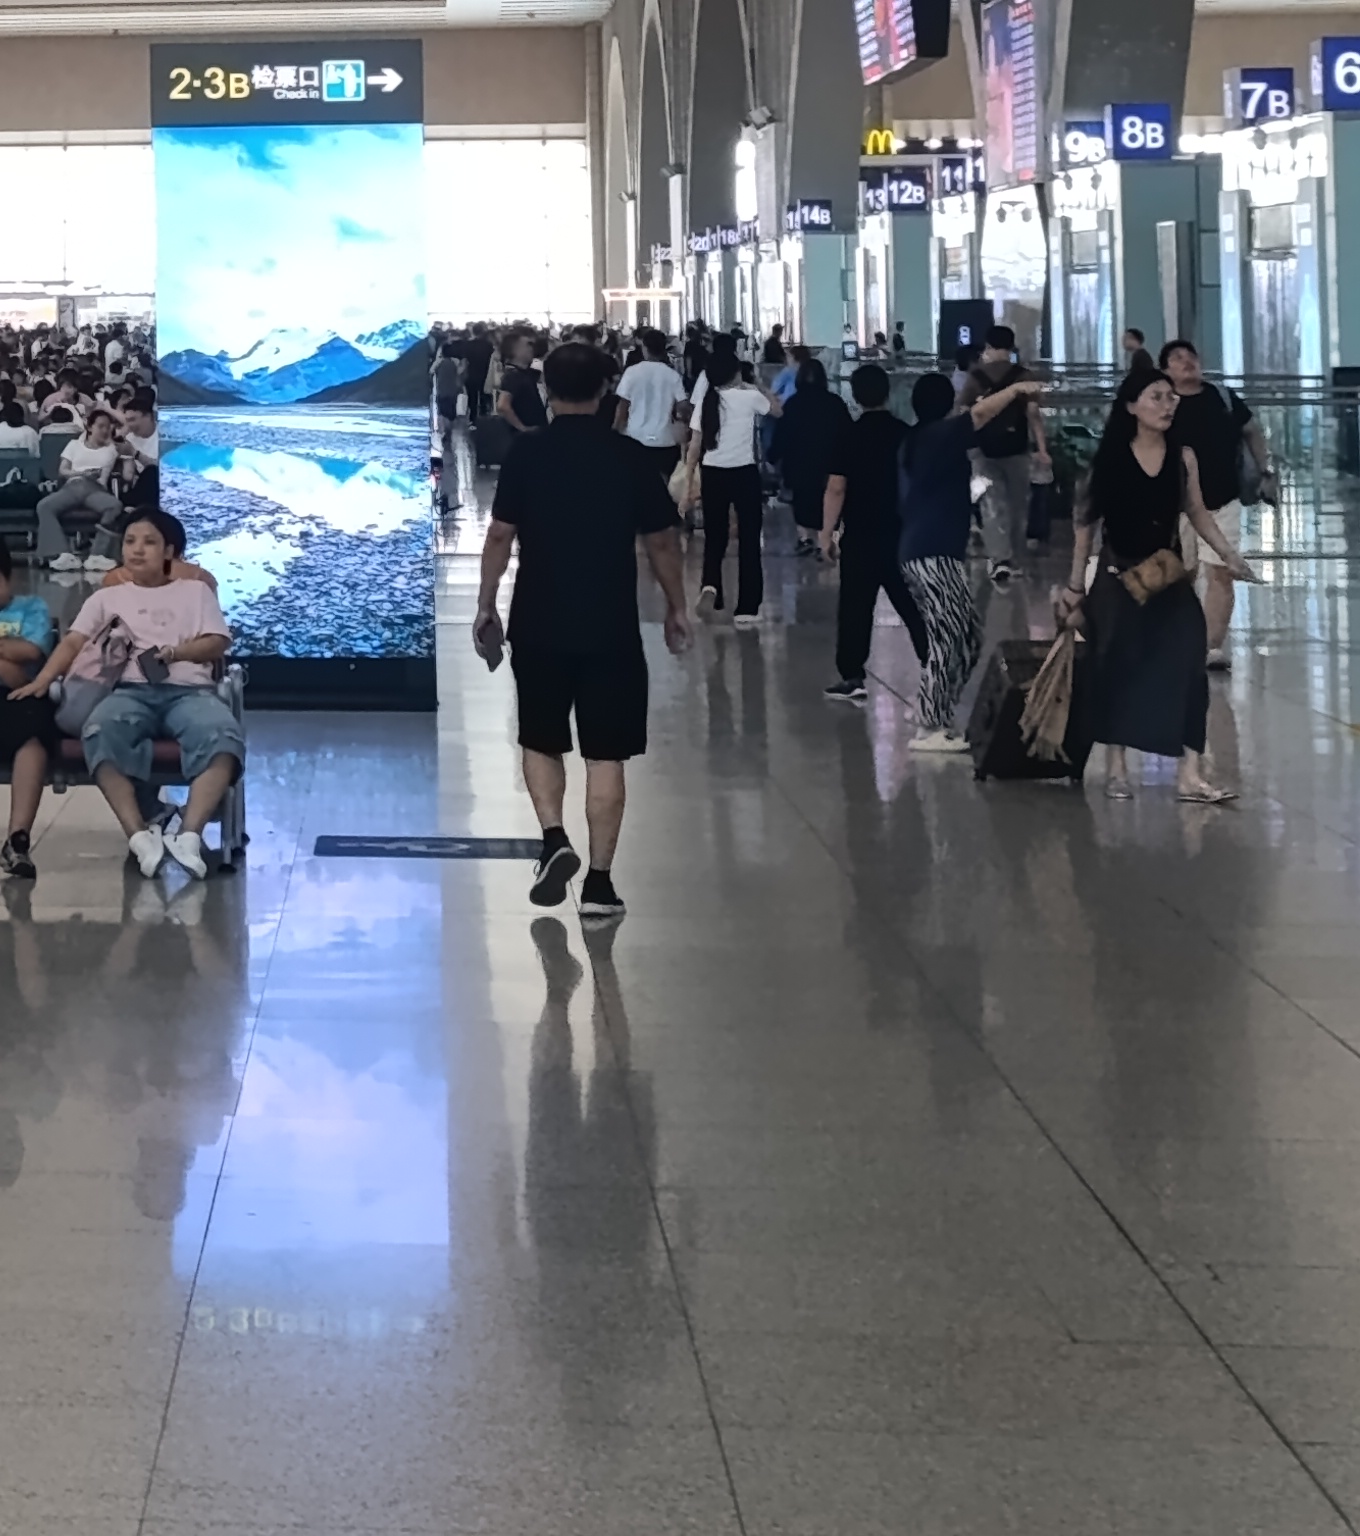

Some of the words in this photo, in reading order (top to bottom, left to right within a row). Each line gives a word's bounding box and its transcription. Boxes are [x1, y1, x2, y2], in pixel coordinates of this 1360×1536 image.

[251, 64, 319, 90] 检票口
[1240, 82, 1290, 118] 7B
[1064, 130, 1106, 162] 9B
[1121, 116, 1165, 148] 8B
[889, 180, 926, 205] 12B
[802, 205, 831, 225] 14B
